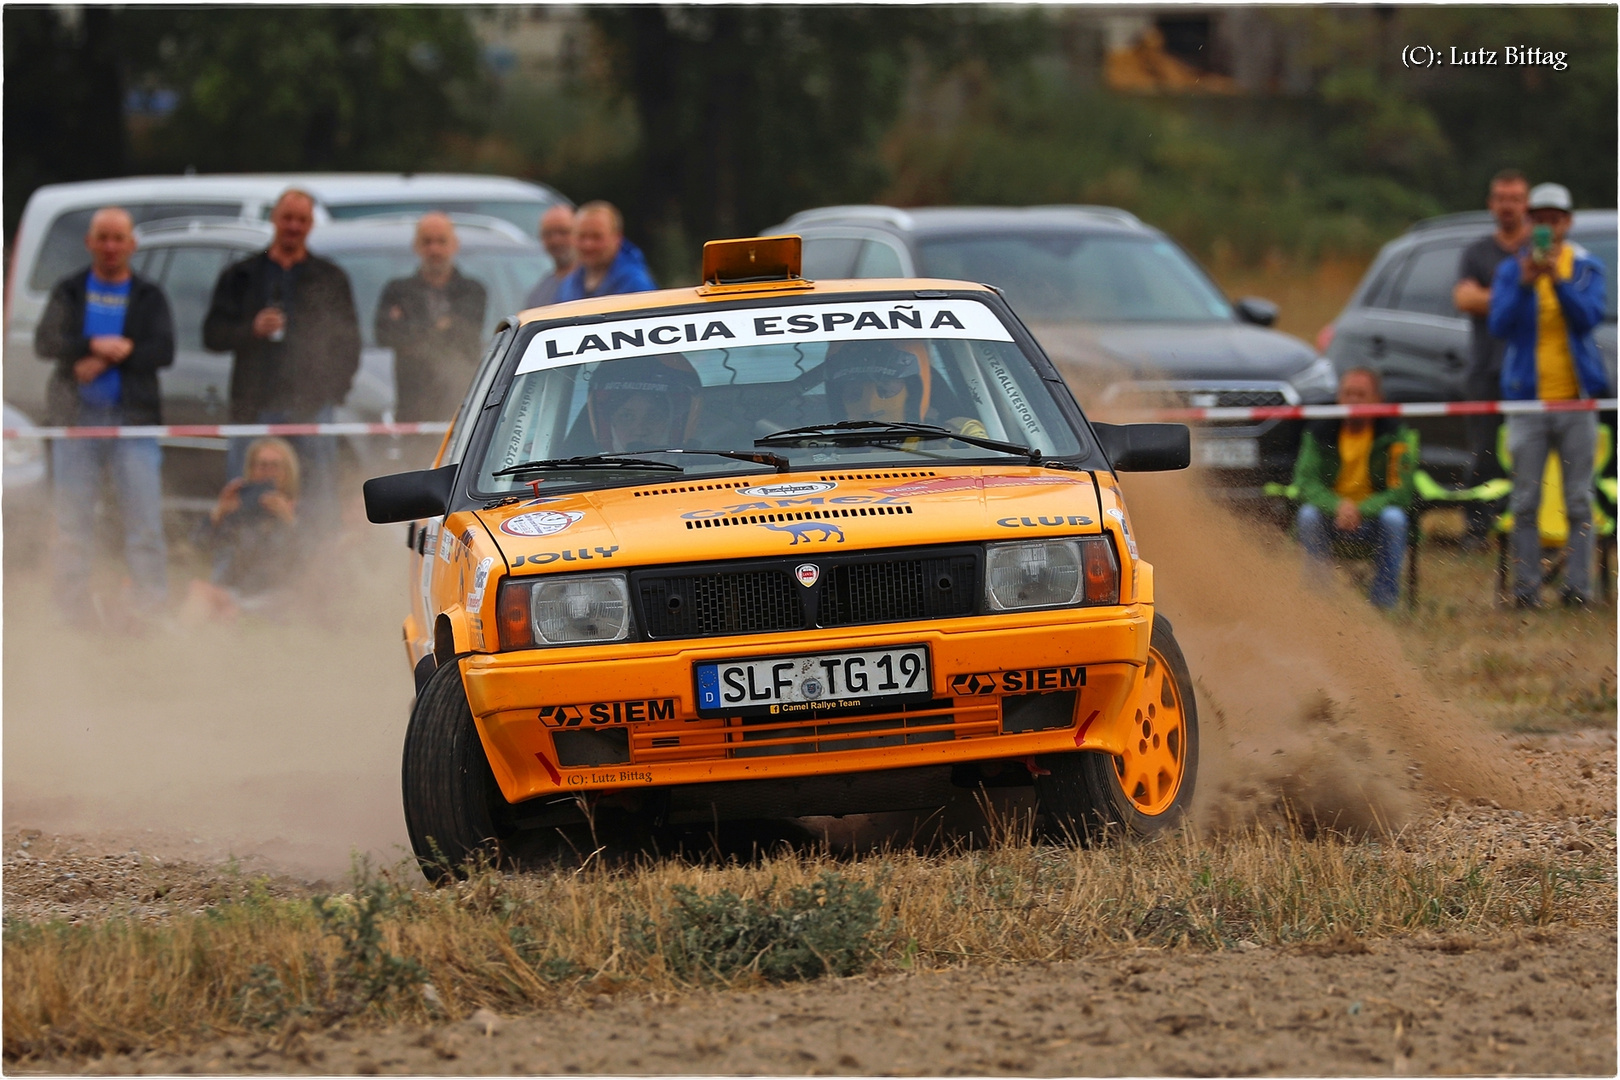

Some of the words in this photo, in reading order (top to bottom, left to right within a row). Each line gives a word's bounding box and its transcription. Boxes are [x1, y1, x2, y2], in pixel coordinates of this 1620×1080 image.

[545, 320, 736, 360] LANCIA
[753, 305, 966, 336] ESPAÑA
[680, 495, 911, 520] CAMEL
[996, 515, 1094, 528] CLUB
[511, 545, 619, 568] JOLLY
[723, 662, 795, 702] SLF
[819, 656, 869, 694] TG
[877, 652, 921, 690] 19
[1002, 667, 1087, 692] SIEM
[705, 692, 715, 703] D
[782, 702, 809, 712] Camel
[810, 701, 837, 710] Rallye
[838, 699, 861, 707] Team
[589, 699, 675, 725] SIEM
